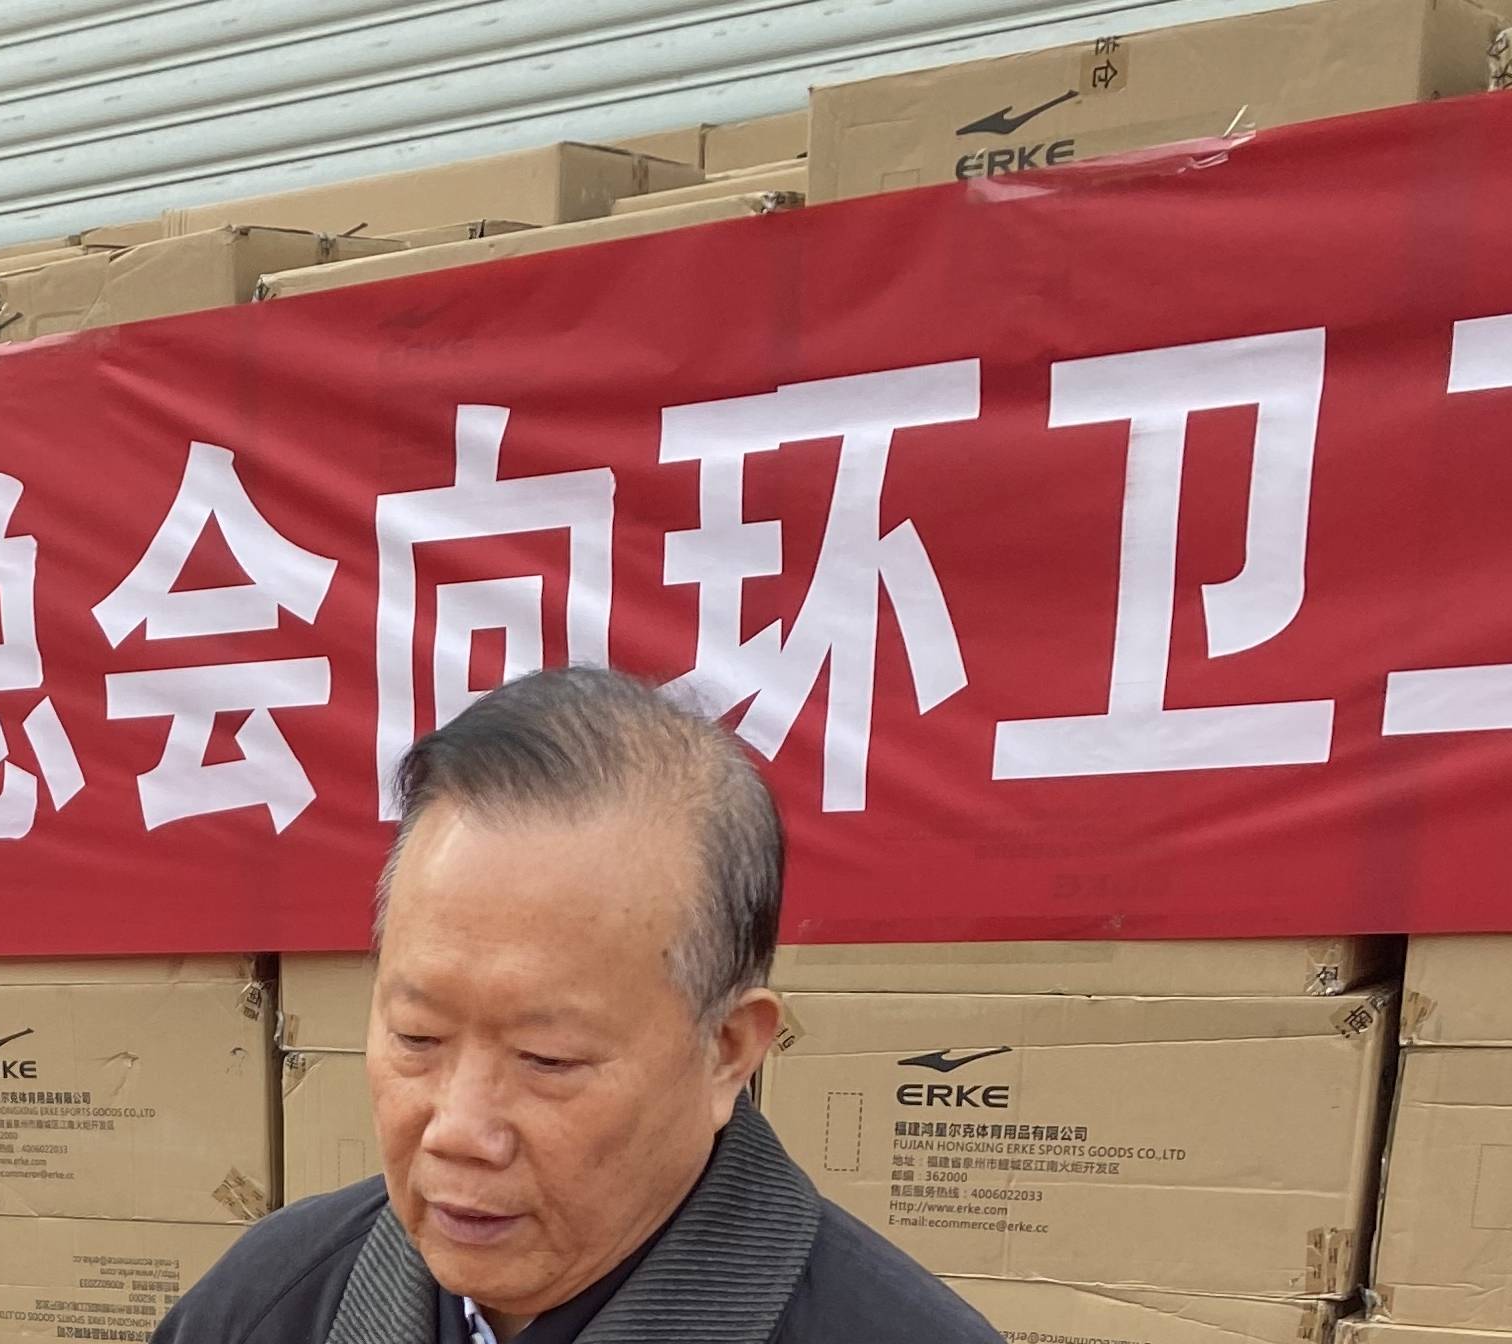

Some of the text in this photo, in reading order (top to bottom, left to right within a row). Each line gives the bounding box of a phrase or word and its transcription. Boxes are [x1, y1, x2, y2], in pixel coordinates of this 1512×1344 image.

[955, 139, 1075, 181] ERKE
[896, 1084, 1010, 1108] ERKE
[92, 1108, 123, 1117] GOODS
[894, 1121, 1088, 1142] 福建鸿星尔克体育用品有限公司
[893, 1139, 934, 1150] FUJIAN
[937, 1140, 1004, 1153] HONGXING
[1006, 1143, 1035, 1155] ERKE
[1038, 1144, 1085, 1157] SPORTS
[1088, 1146, 1134, 1159] GOODS
